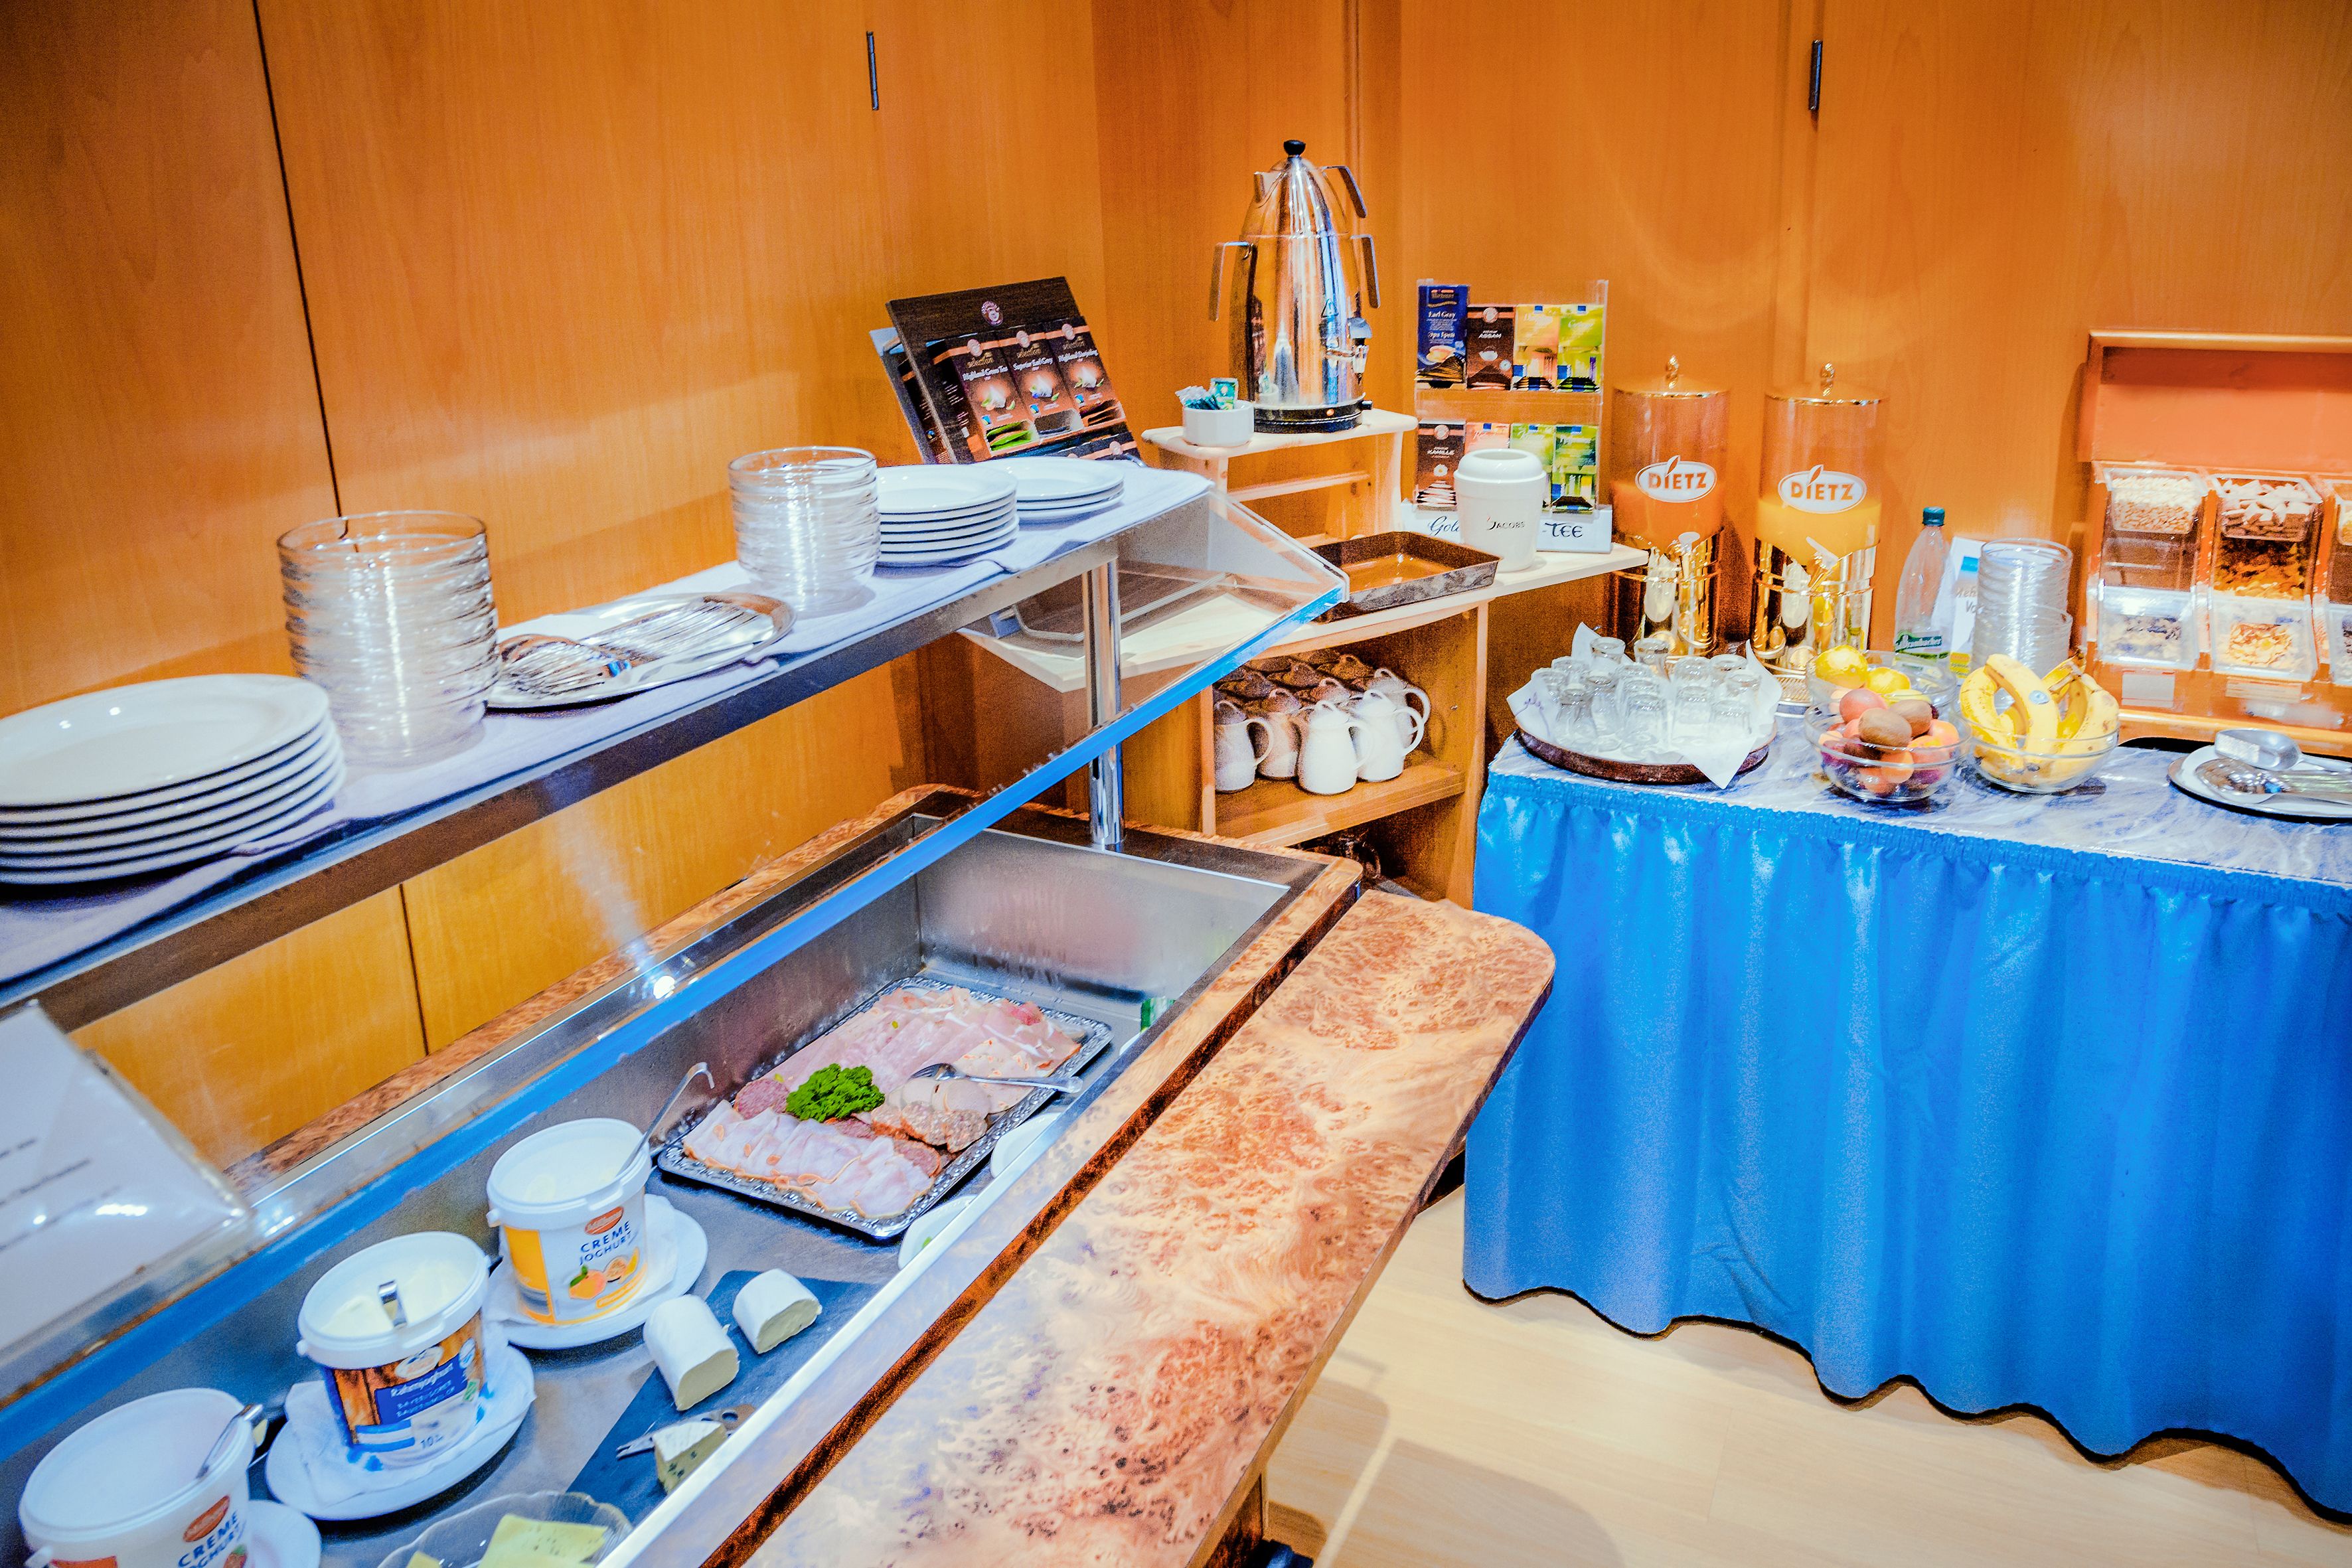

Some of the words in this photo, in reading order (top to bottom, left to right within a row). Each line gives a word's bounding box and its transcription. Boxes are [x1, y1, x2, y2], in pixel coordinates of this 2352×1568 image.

[1647, 471, 1708, 490] DIETZ
[1790, 481, 1855, 502] DIETZ
[580, 1220, 631, 1253] CREME
[177, 1510, 238, 1567] CREME
